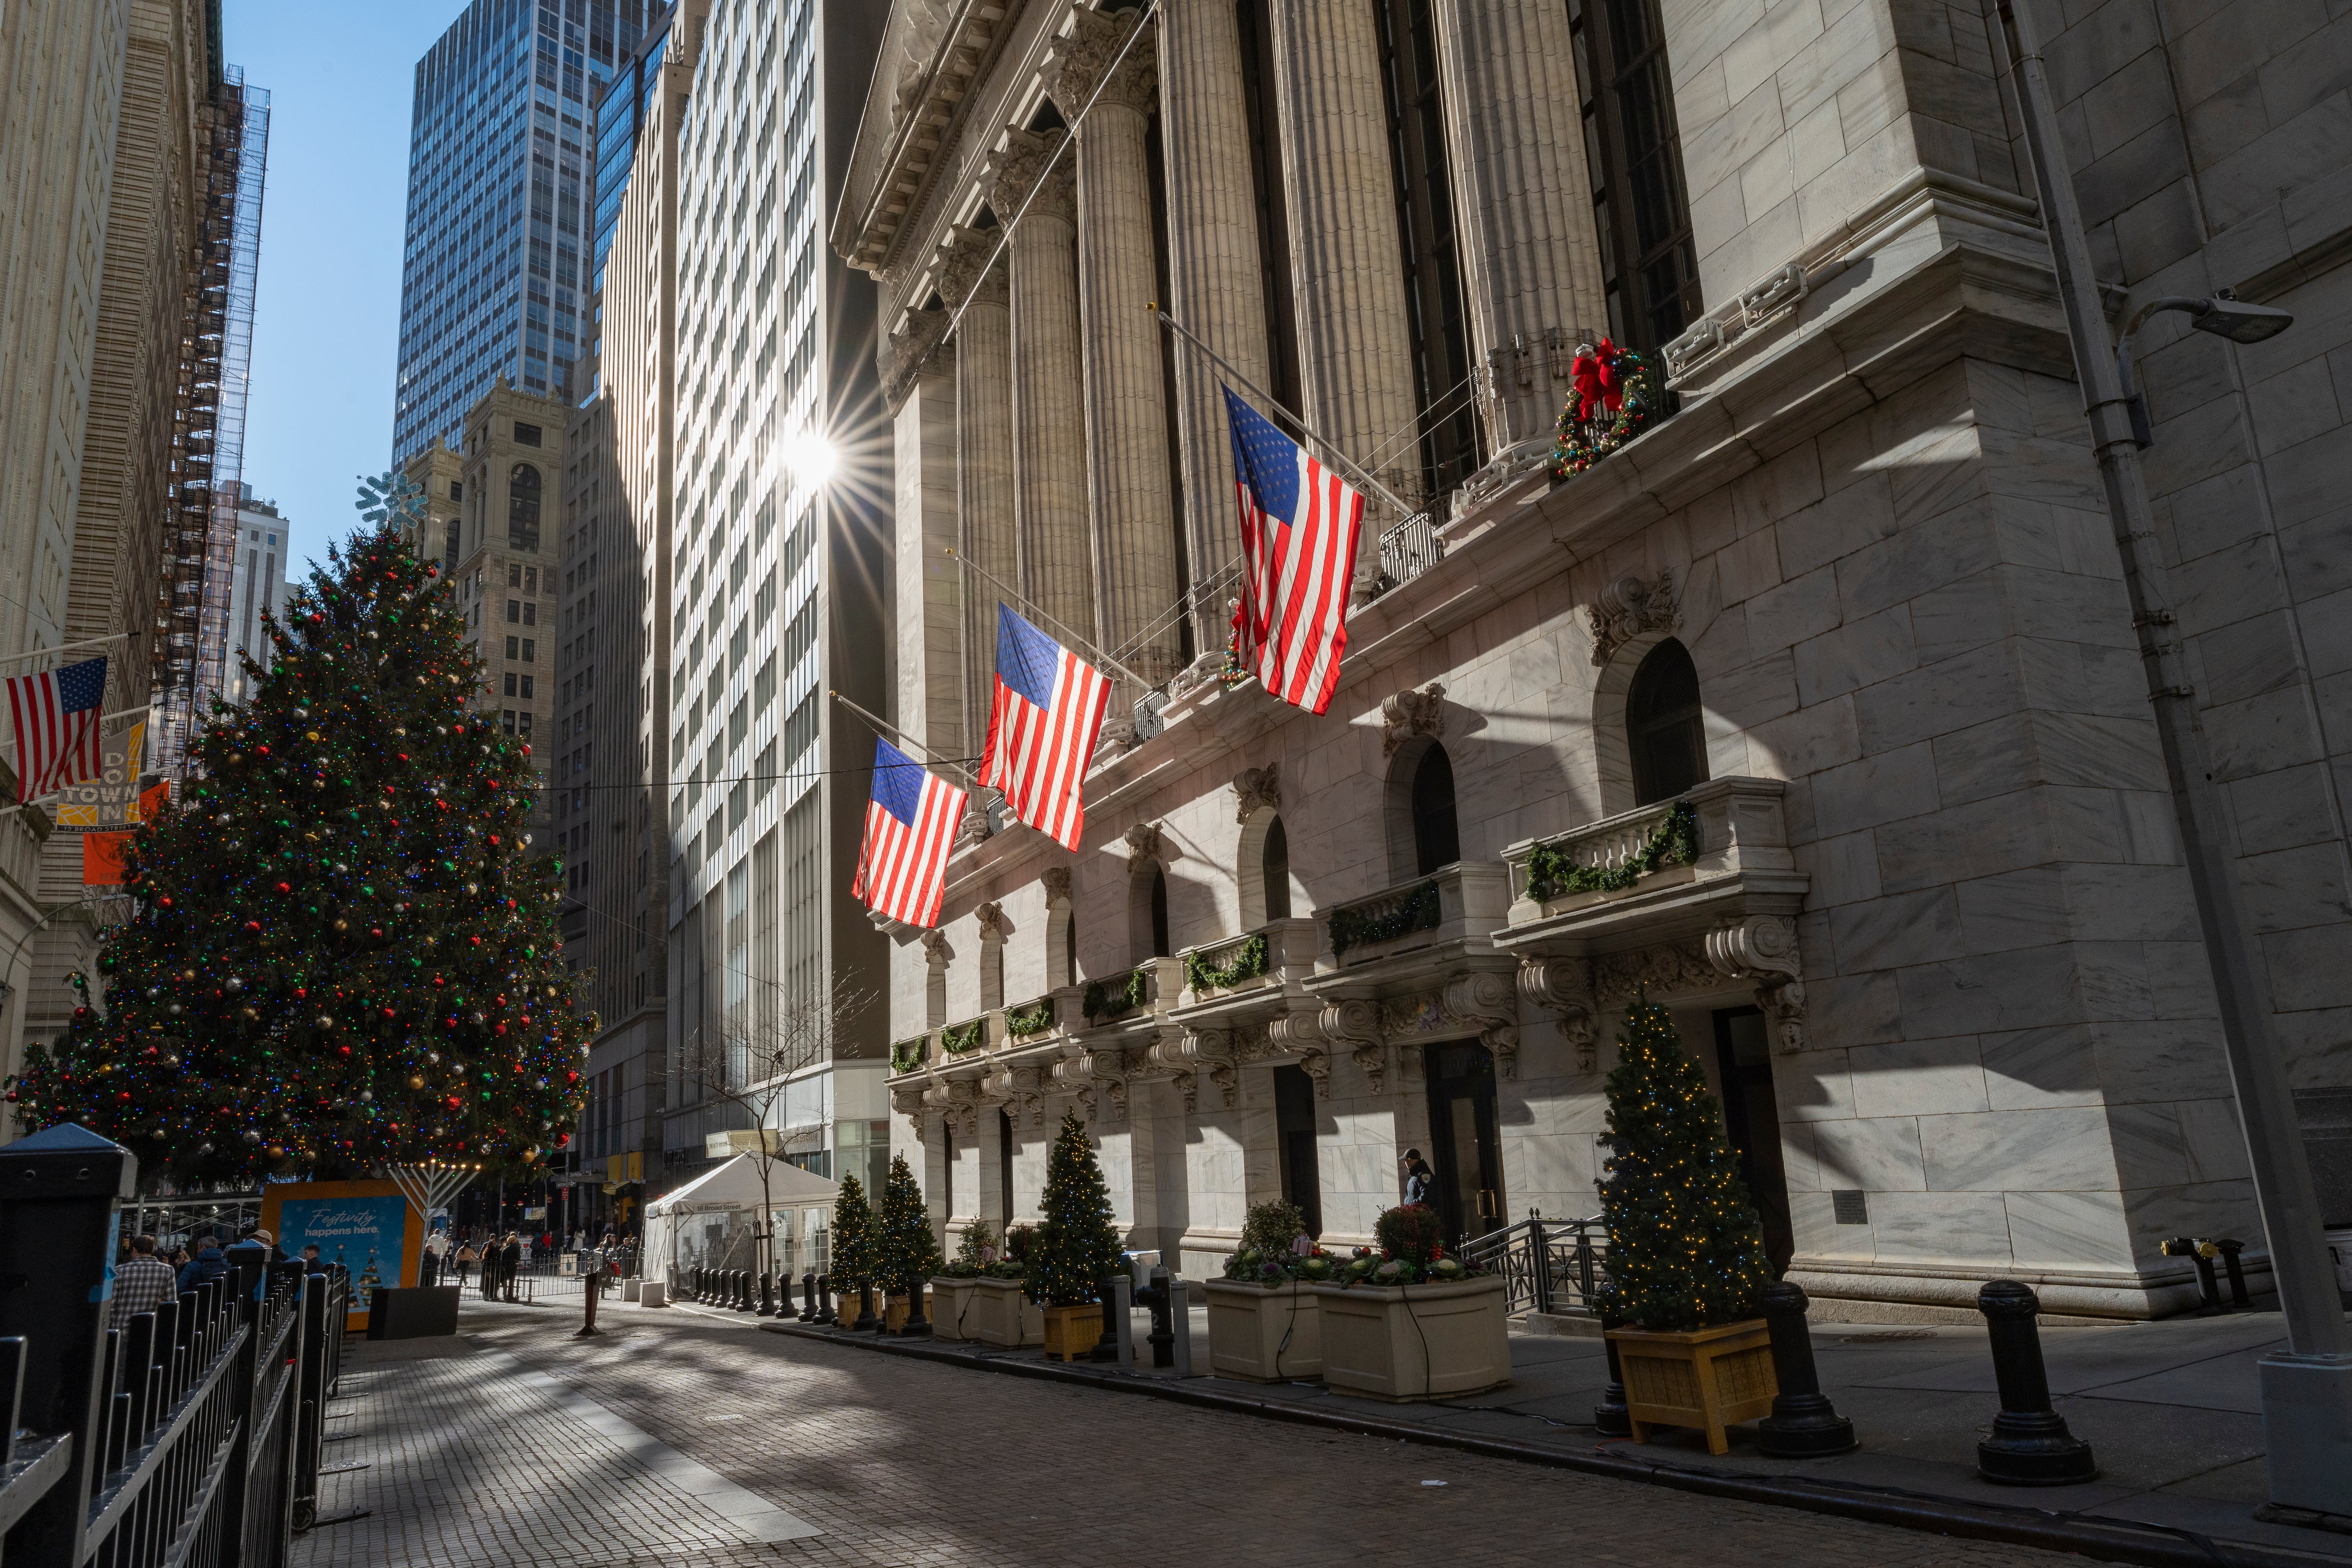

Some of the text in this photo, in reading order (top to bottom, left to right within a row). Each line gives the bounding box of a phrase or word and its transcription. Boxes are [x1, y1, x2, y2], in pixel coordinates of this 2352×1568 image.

[64, 785, 137, 803] TOWN
[308, 1209, 377, 1227] Festivity
[305, 1226, 380, 1237] happens here.
[1152, 1313, 1159, 1329] 2
